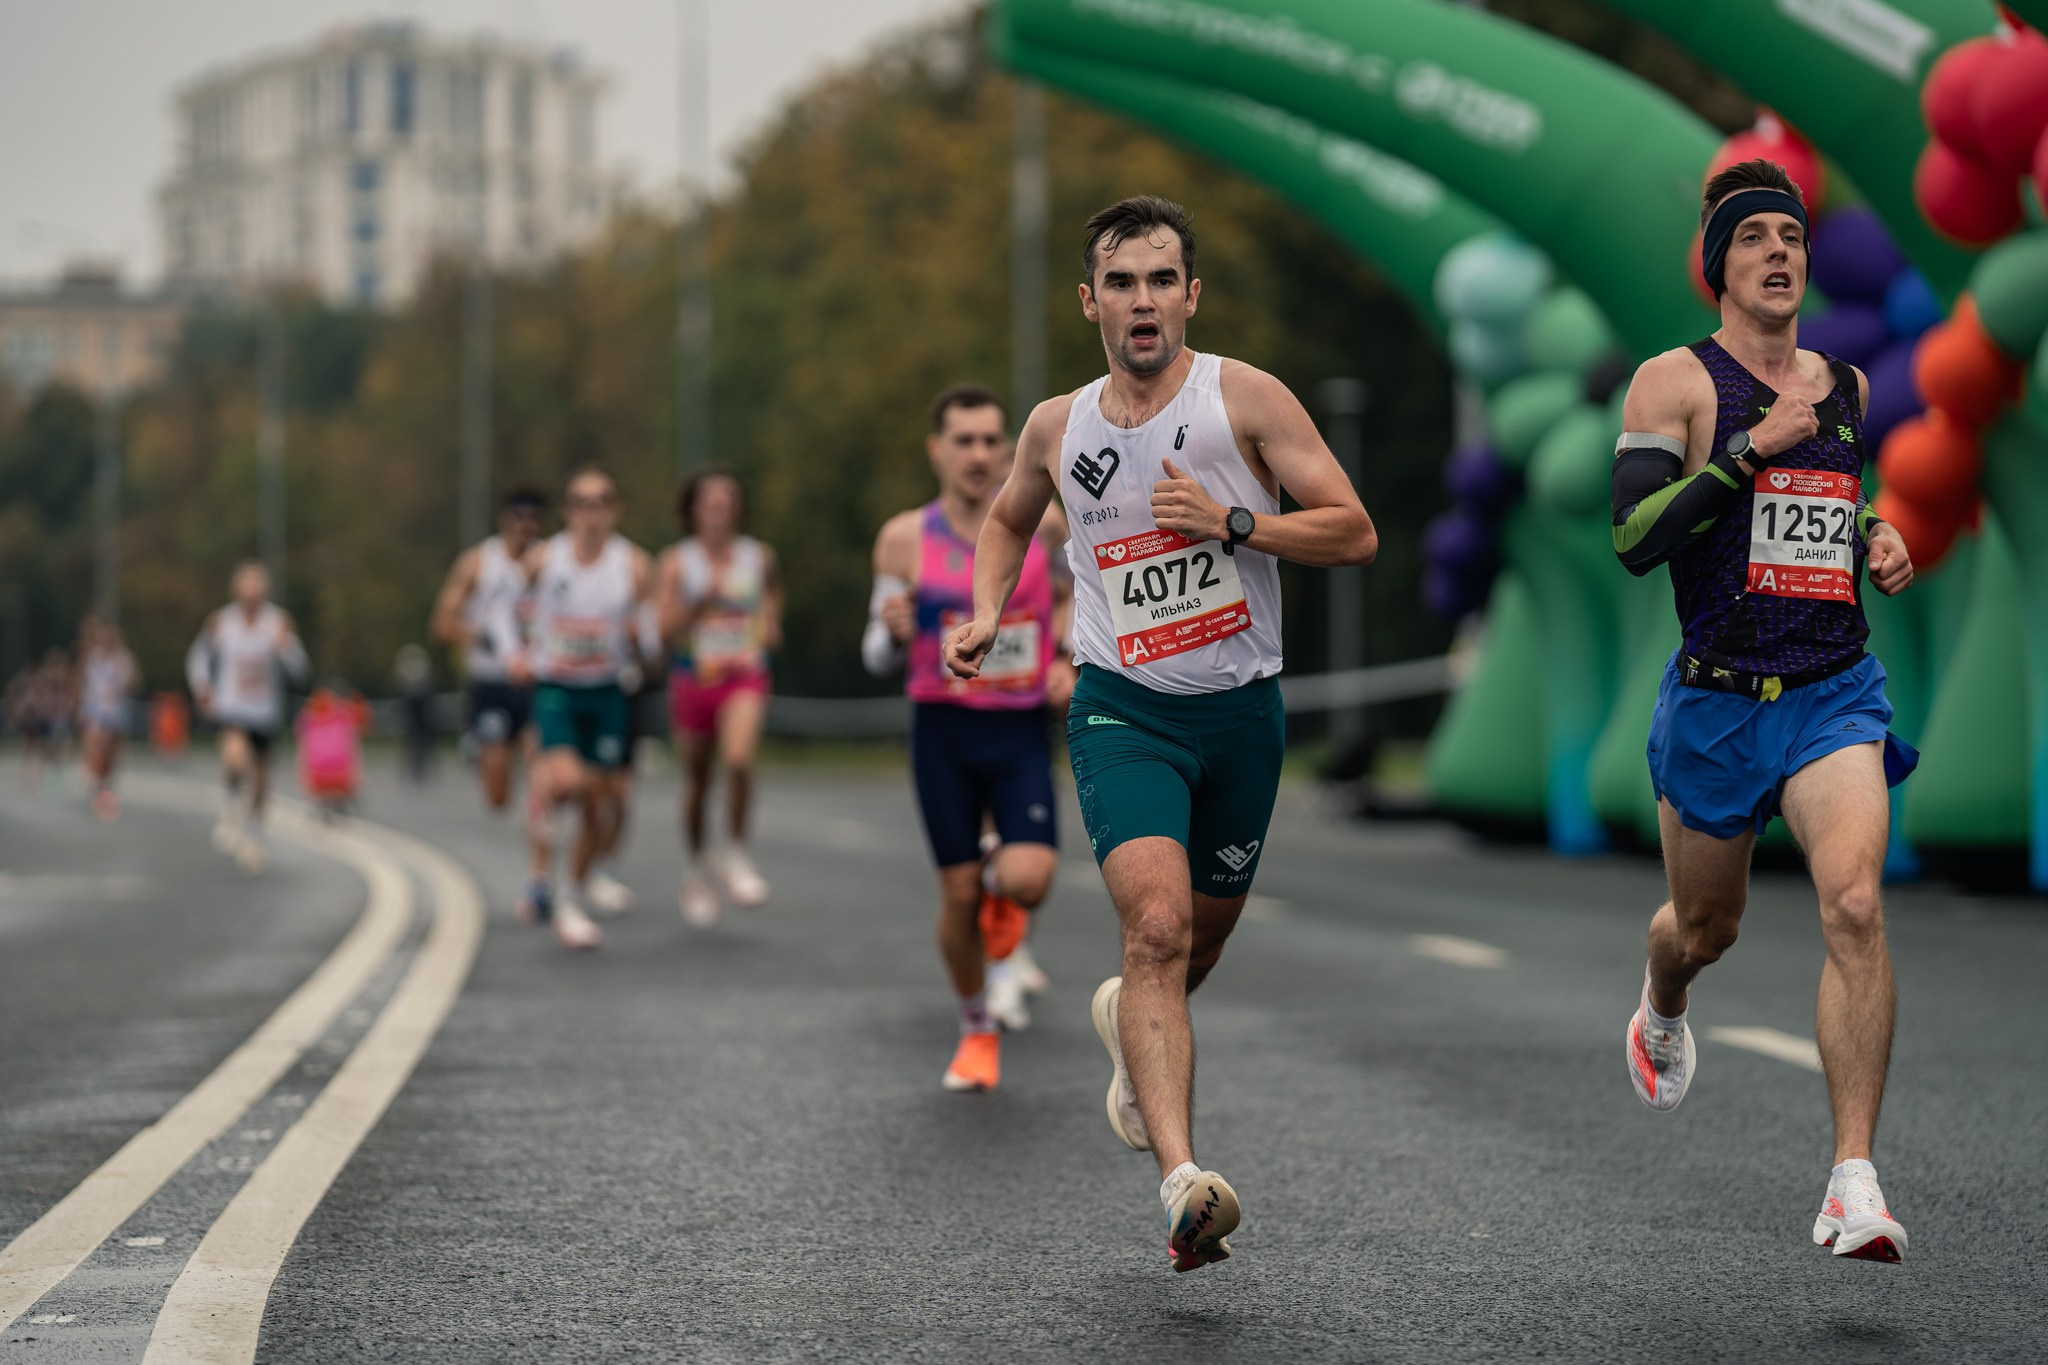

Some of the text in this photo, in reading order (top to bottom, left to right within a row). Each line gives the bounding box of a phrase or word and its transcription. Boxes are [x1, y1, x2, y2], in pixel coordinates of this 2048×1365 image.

[1792, 485, 1823, 493] МАРАФОН
[1793, 479, 1833, 488] МОСКОВСКИЙ
[1096, 506, 1119, 523] 2012
[1127, 533, 1161, 546] СБЕРПРАЙМ
[1128, 535, 1174, 552] МОСКОВСКИЙ
[1130, 544, 1164, 558] МАРАФОН
[1795, 548, 1836, 561] ДАНИЛ
[1122, 551, 1221, 608] 4072
[1150, 597, 1202, 621] ИЛЬНАЗ
[1227, 873, 1249, 883] 2012
